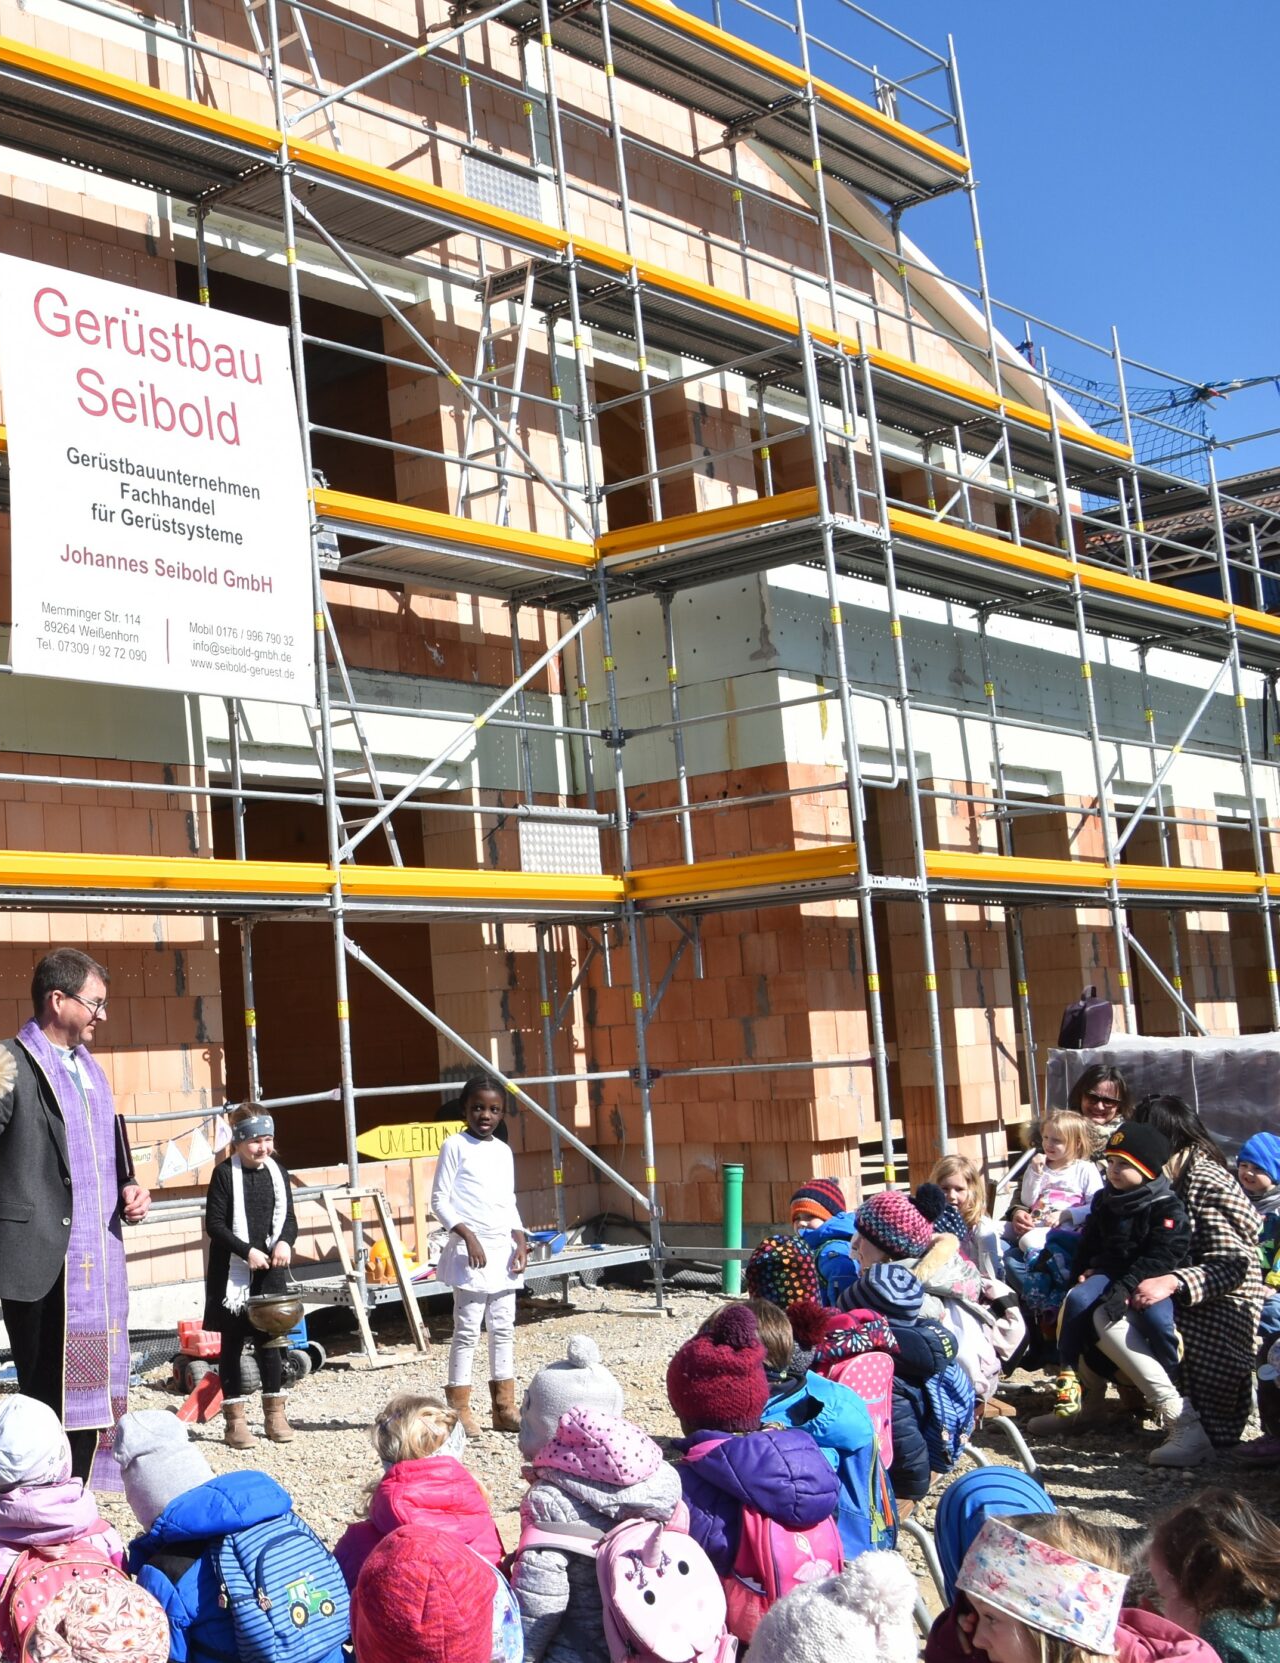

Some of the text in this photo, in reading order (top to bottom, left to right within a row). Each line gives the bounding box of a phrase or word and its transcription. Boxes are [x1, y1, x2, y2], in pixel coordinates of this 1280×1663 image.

[33, 287, 263, 385] Gerüstbau
[76, 367, 241, 447] Seibold
[66, 447, 261, 501] Gerüstbauunternehmen
[120, 483, 216, 517] Fachhandel
[91, 503, 244, 547] für Gerüstsysteme
[60, 544, 274, 595] Johannes Seibold GmbH
[41, 601, 142, 626] Memminger Str. 114
[36, 636, 55, 652] Tel.
[58, 641, 90, 656] 07309
[98, 645, 113, 658] 92
[44, 620, 140, 644] 89264 Weißenhorn
[189, 621, 215, 637] Mobil
[216, 624, 239, 640] 0176
[283, 634, 295, 647] 32
[192, 639, 293, 664] info@seibold-gmbh.de
